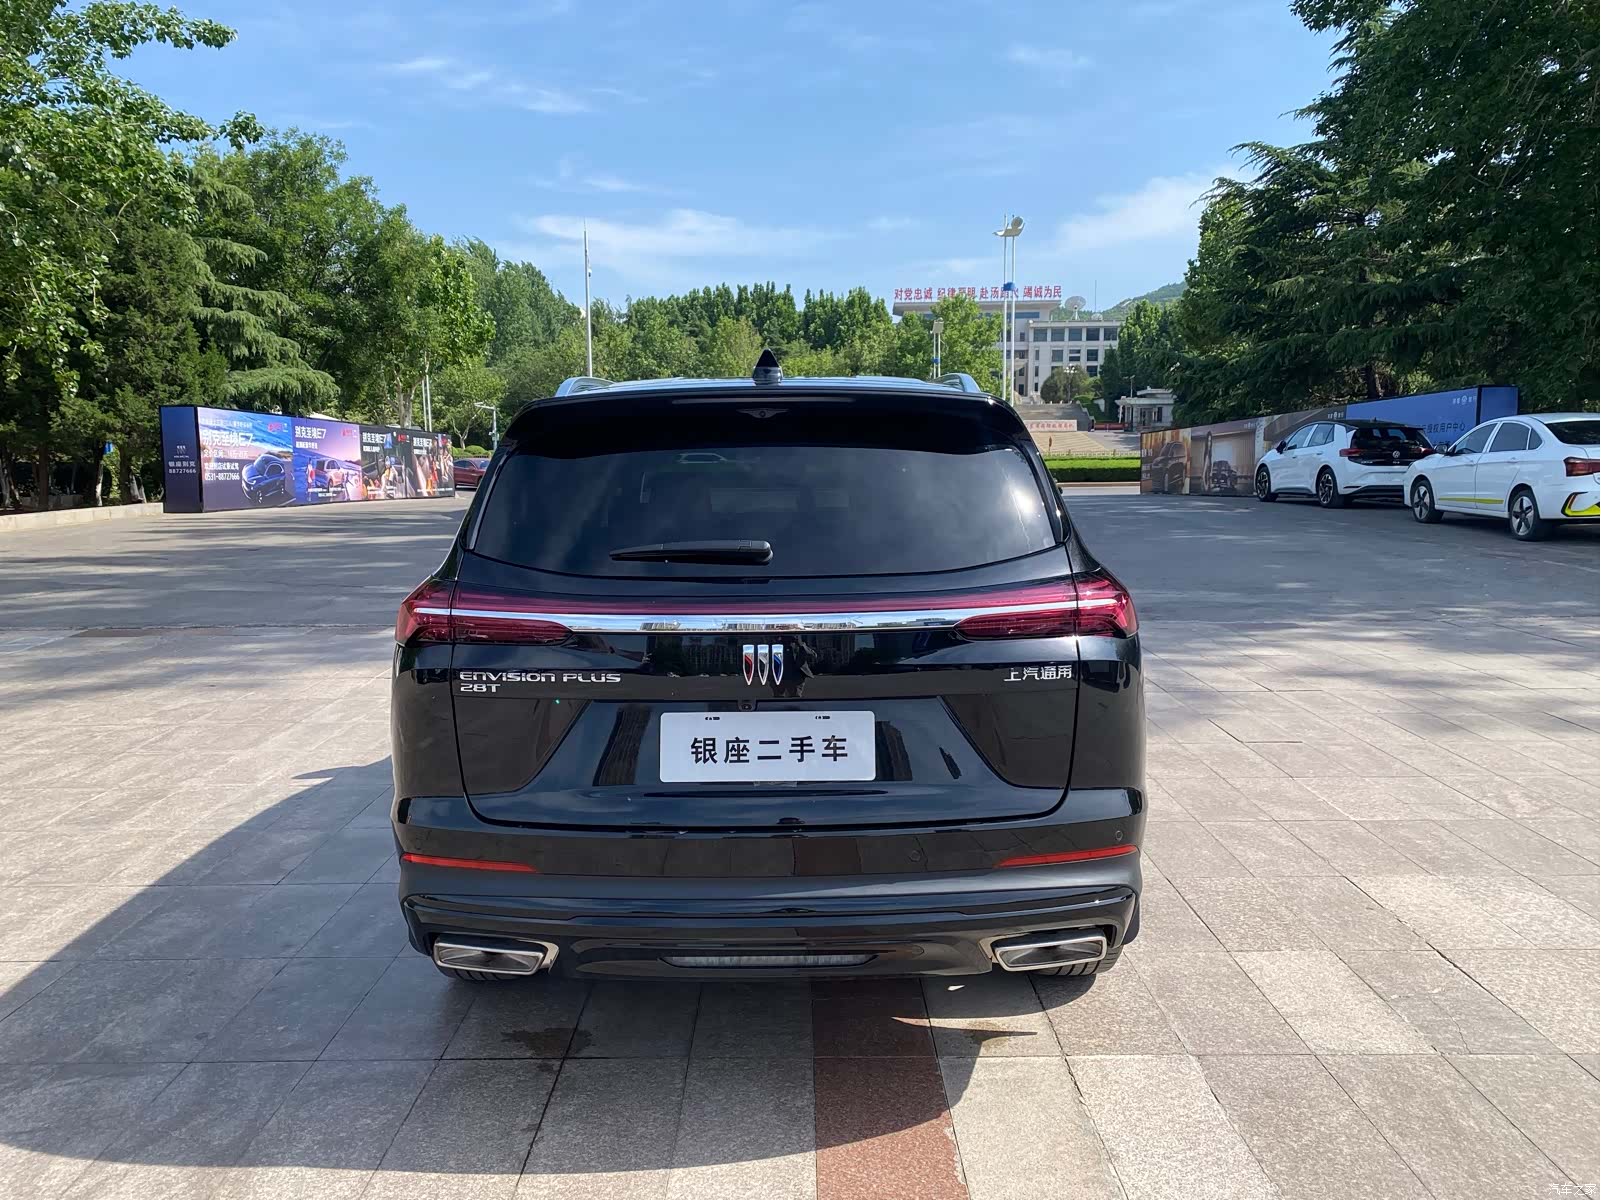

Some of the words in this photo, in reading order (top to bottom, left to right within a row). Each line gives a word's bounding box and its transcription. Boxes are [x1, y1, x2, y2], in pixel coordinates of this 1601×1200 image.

[894, 287, 933, 301] 对党忠诚
[1023, 285, 1062, 298] 竭诚为民
[202, 430, 253, 448] 别克至境E7
[563, 673, 622, 683] PLUS
[1003, 664, 1073, 682] 上汽通用
[460, 683, 501, 693] 28T
[690, 735, 848, 764] 银座二手车
